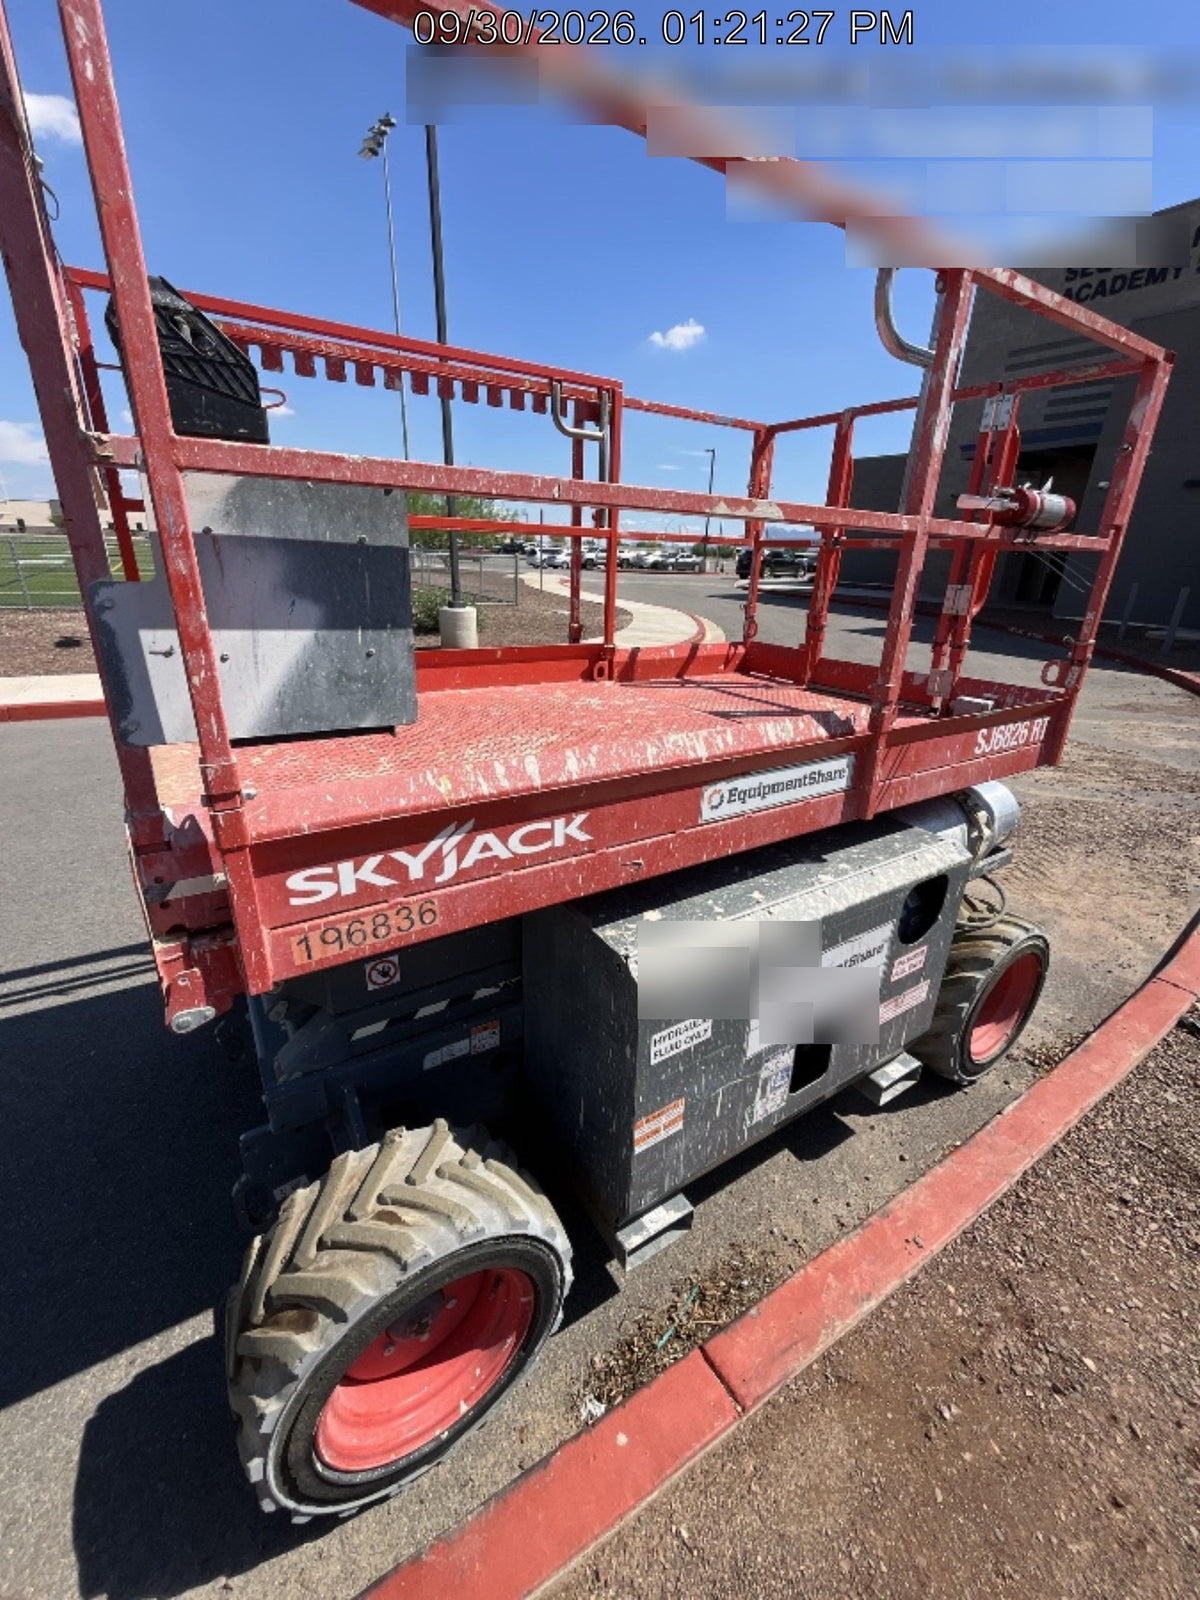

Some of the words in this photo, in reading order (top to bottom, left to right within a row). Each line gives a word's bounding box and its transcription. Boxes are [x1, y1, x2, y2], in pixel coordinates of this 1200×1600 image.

[1062, 267, 1182, 303] ACADEMY
[974, 721, 1030, 754] SJ6826
[1029, 716, 1051, 742] RT
[727, 767, 846, 804] EquipmentShare
[286, 812, 594, 906] SKYJACK
[296, 899, 438, 960] 196836
